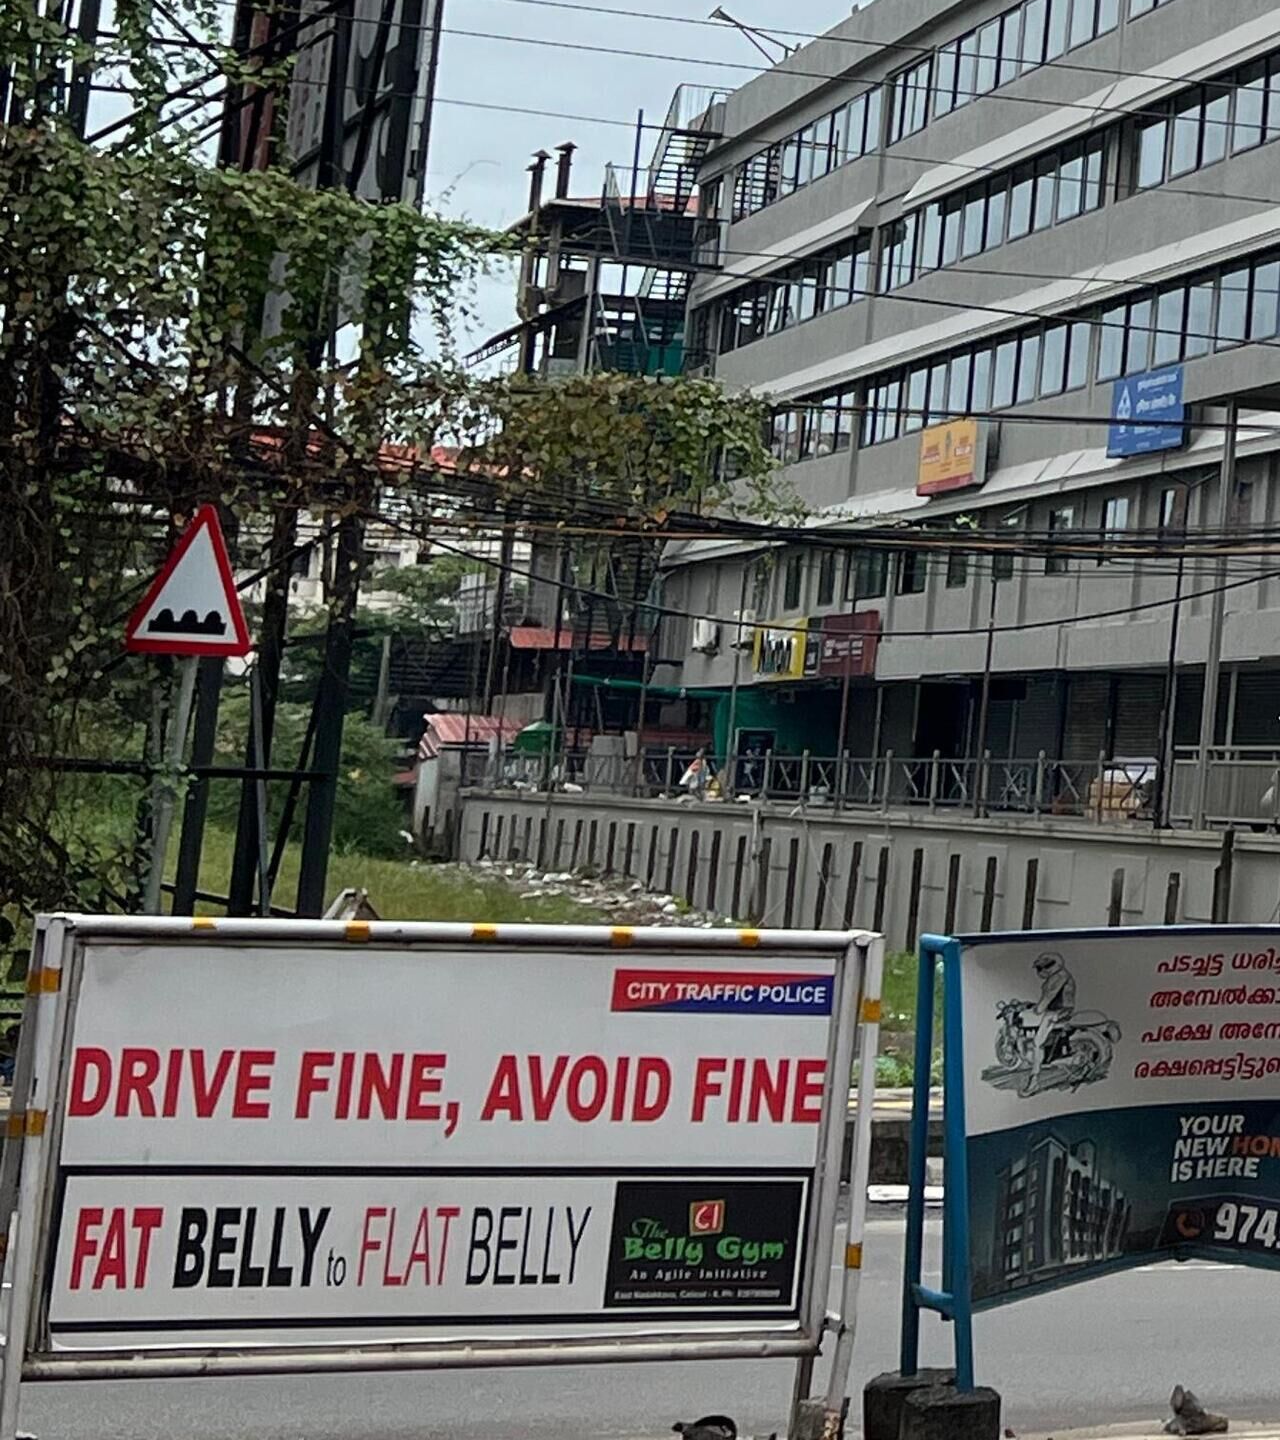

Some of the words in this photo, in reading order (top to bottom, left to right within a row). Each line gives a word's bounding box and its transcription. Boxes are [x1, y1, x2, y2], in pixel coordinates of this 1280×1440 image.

[1158, 955, 1224, 976] പടച്ചട്ട
[627, 982, 670, 1001] CITY
[675, 983, 752, 1003] TRAFFIC
[758, 985, 826, 1004] POLICE
[1142, 1022, 1210, 1043] പക്ഷേ
[68, 1047, 275, 1119] DRIVE
[294, 1050, 461, 1138] FINE,
[481, 1055, 672, 1122] AVOID
[691, 1057, 827, 1123] FINE
[1179, 1115, 1245, 1136] YOUR
[1174, 1137, 1230, 1159] NEW
[1171, 1160, 1193, 1183] IS
[1196, 1157, 1260, 1179] HERE
[69, 1207, 164, 1290] FAT
[173, 1206, 331, 1288] BELLY
[326, 1249, 346, 1287] to
[357, 1206, 461, 1286] FLAT
[465, 1206, 592, 1284] BELLY
[623, 1236, 703, 1266] Belly
[717, 1236, 784, 1266] Gym
[629, 1269, 647, 1280] An
[655, 1269, 691, 1281] Agile
[699, 1268, 768, 1280] Initiative
